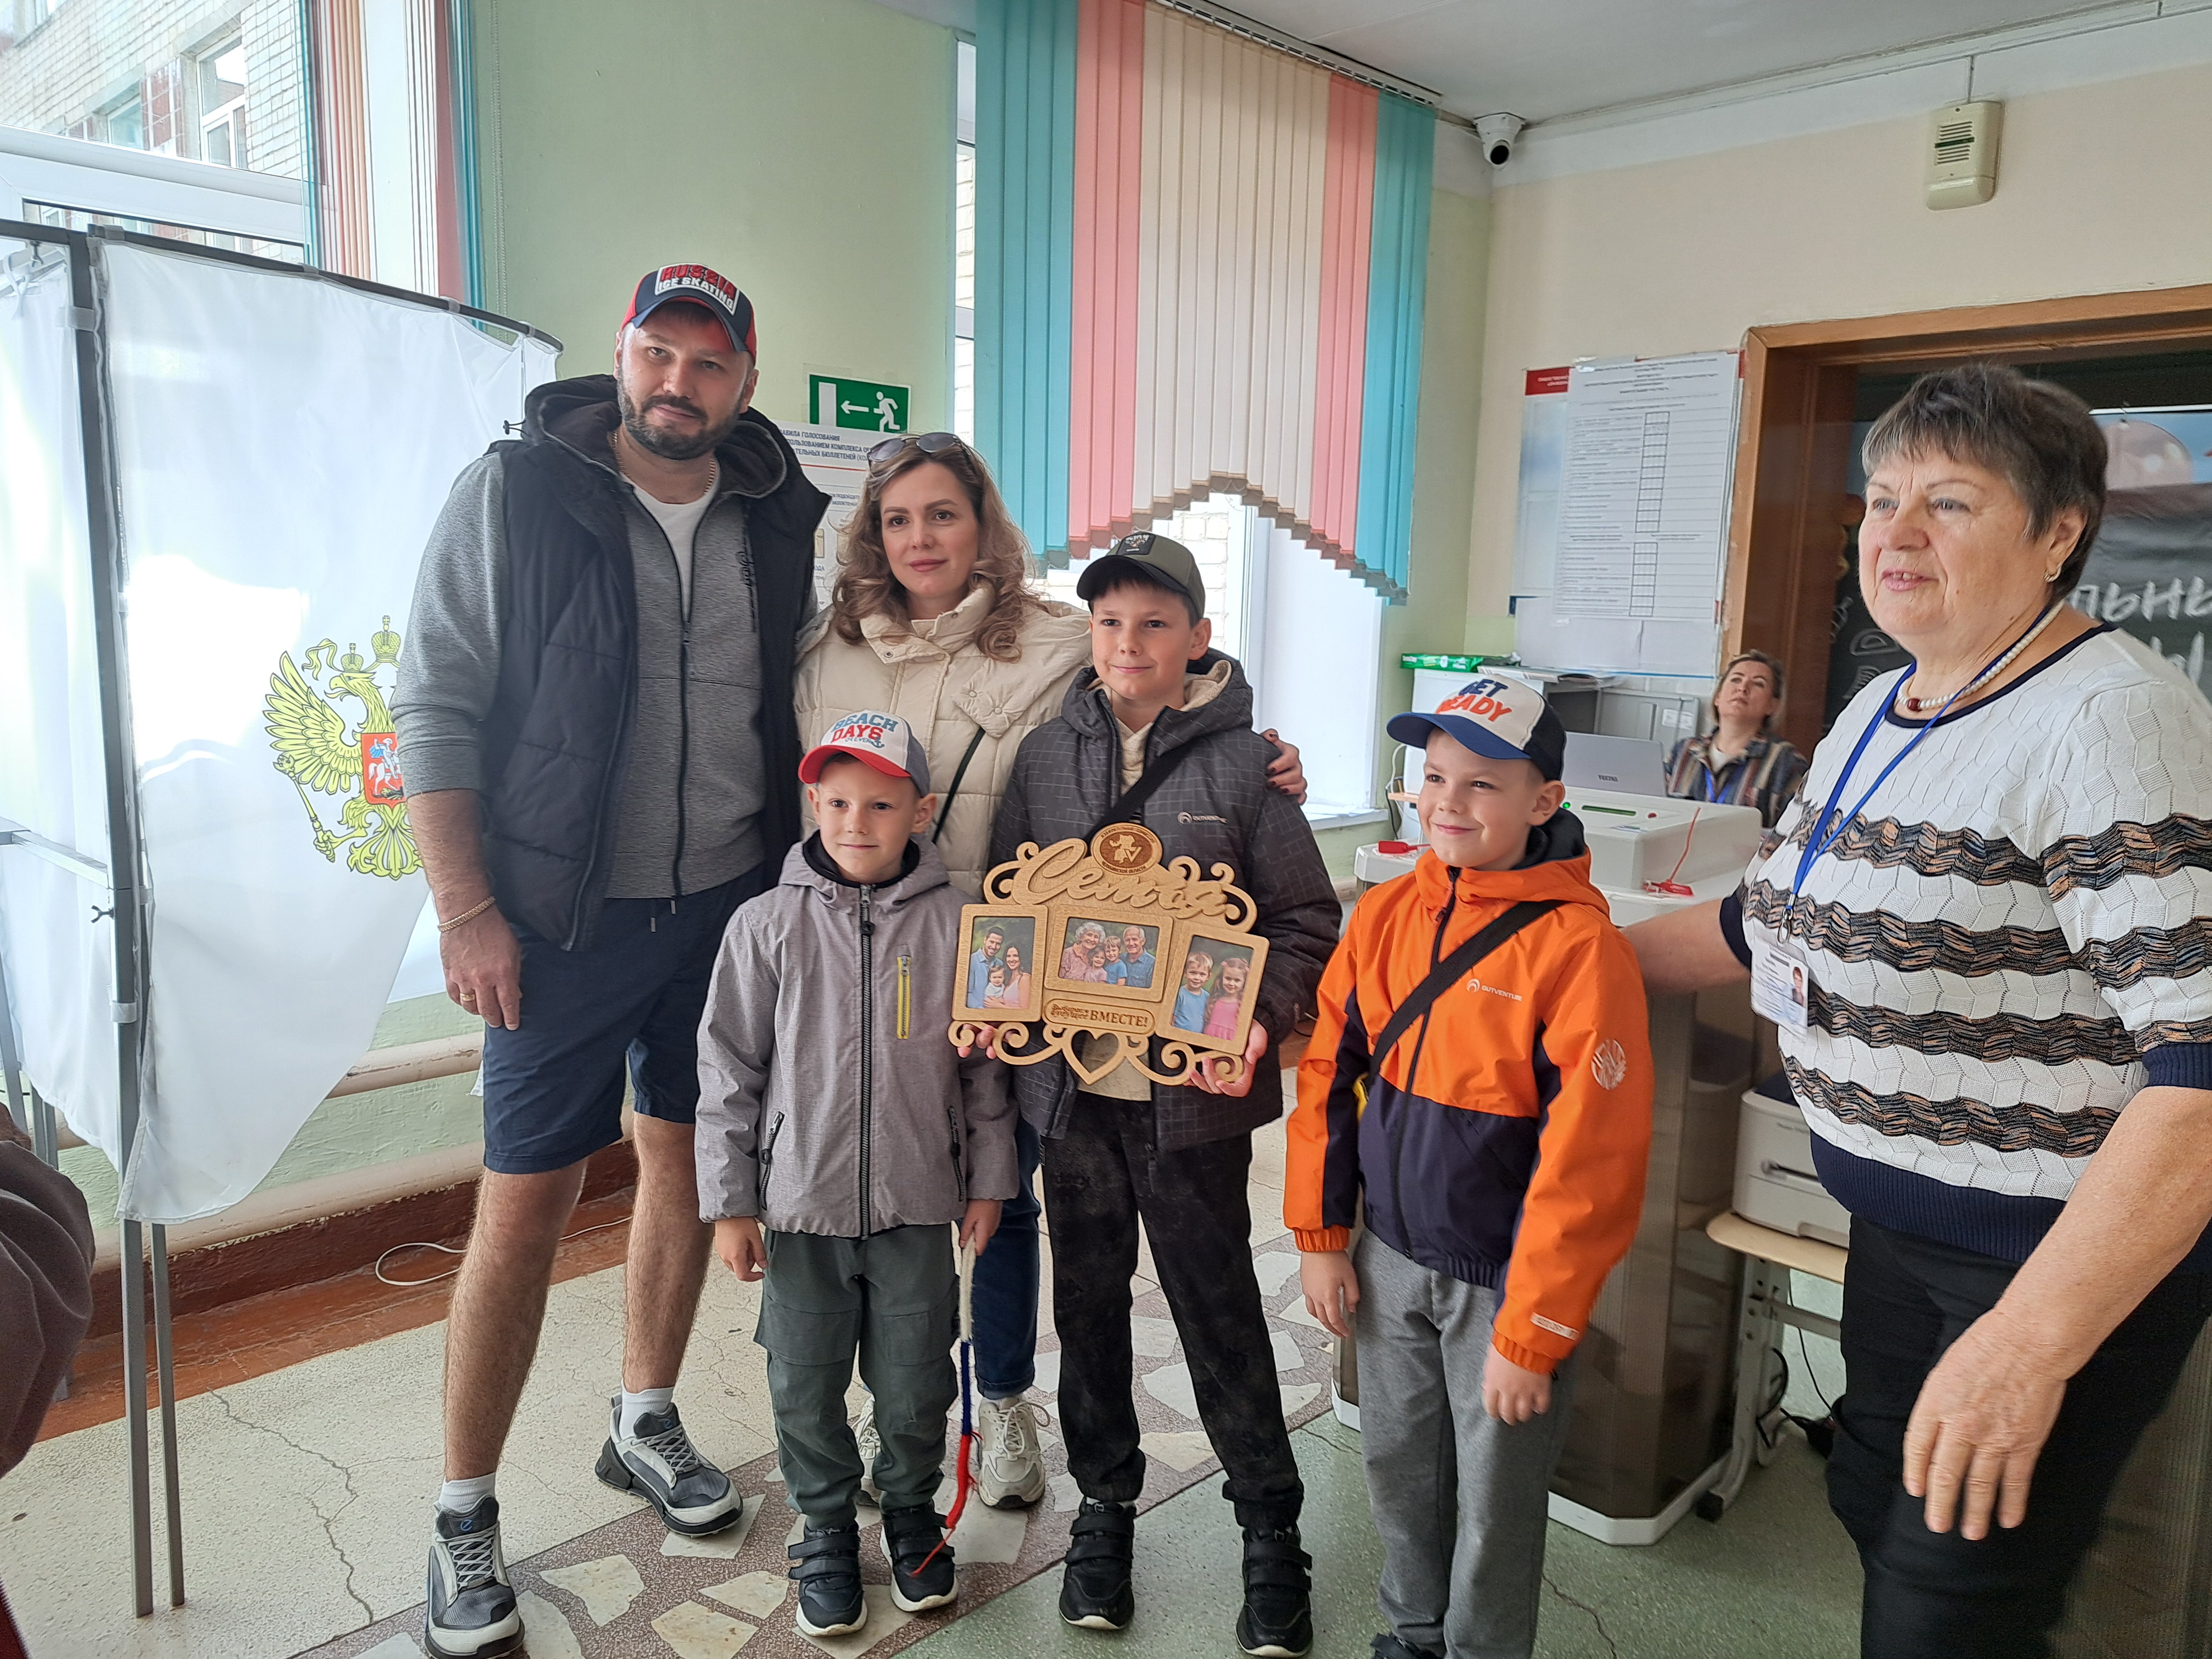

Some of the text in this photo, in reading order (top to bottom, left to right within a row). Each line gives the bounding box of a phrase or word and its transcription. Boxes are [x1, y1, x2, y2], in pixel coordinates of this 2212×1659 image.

[661, 264, 736, 300] RUSSIA
[659, 277, 733, 309] ICE SKATING
[1458, 678, 1509, 697] GET
[830, 713, 899, 733] BEACH
[830, 724, 884, 744] DAYS
[1090, 1009, 1149, 1028] ВМЕСТЕ!
